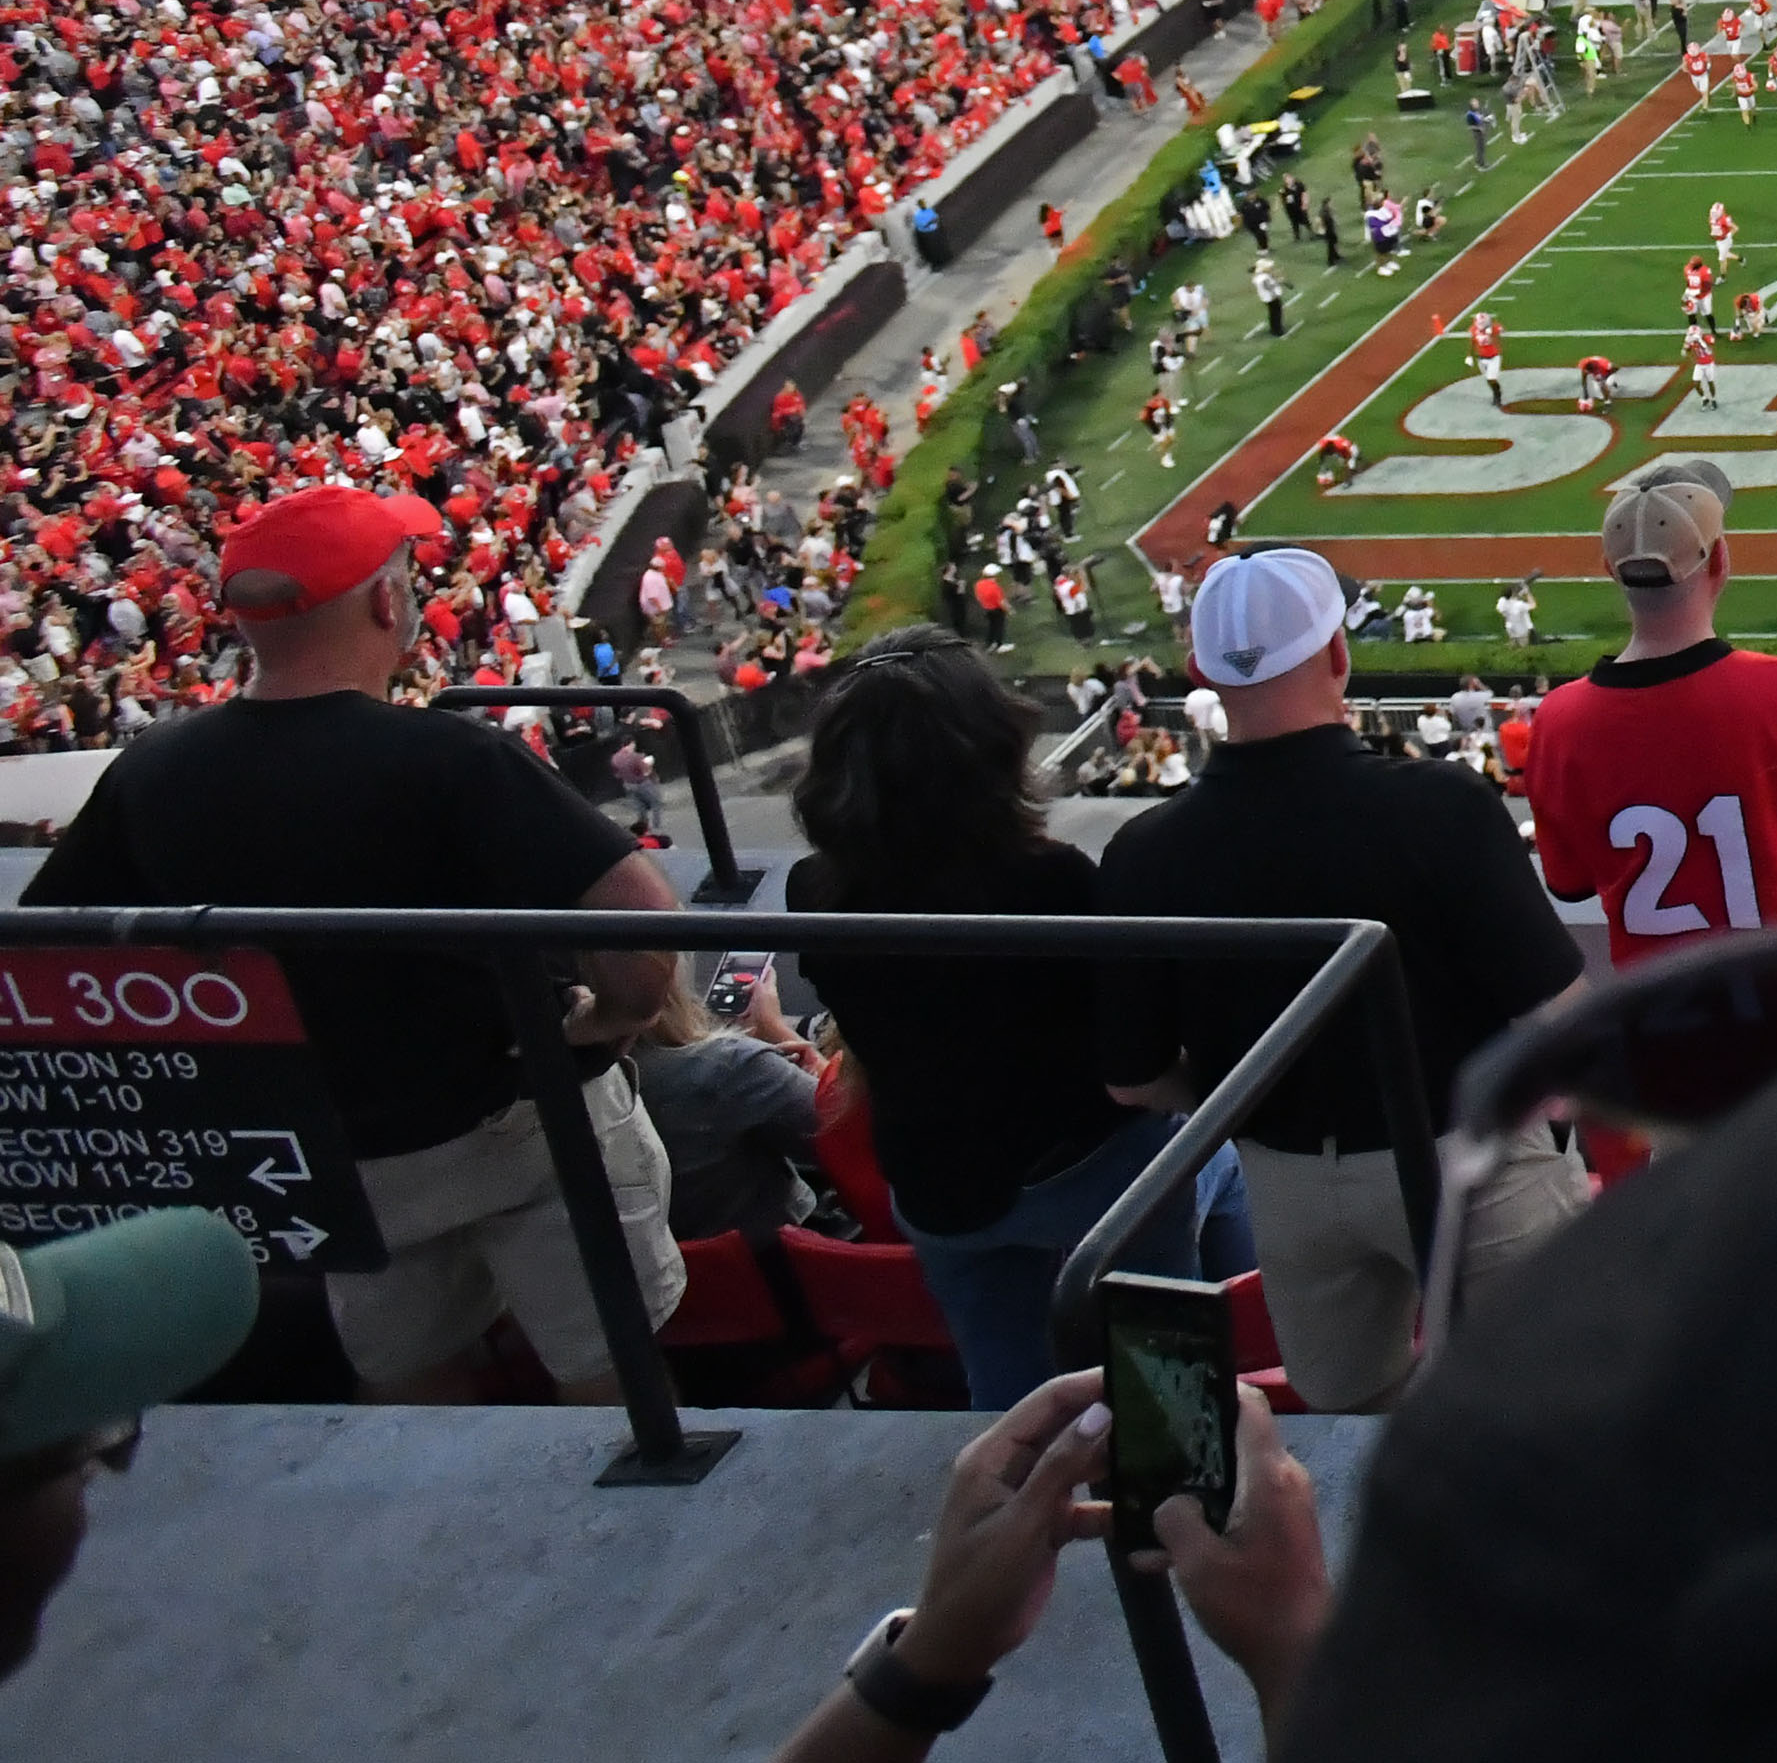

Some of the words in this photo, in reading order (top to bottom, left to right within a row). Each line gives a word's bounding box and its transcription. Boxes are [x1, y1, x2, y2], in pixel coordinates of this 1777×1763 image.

[1607, 793, 1763, 936] 21
[66, 969, 249, 1028] 300
[127, 1050, 200, 1080] 319
[60, 1083, 144, 1113] 1-10
[156, 1128, 230, 1157] 319
[91, 1160, 195, 1189] 11-25
